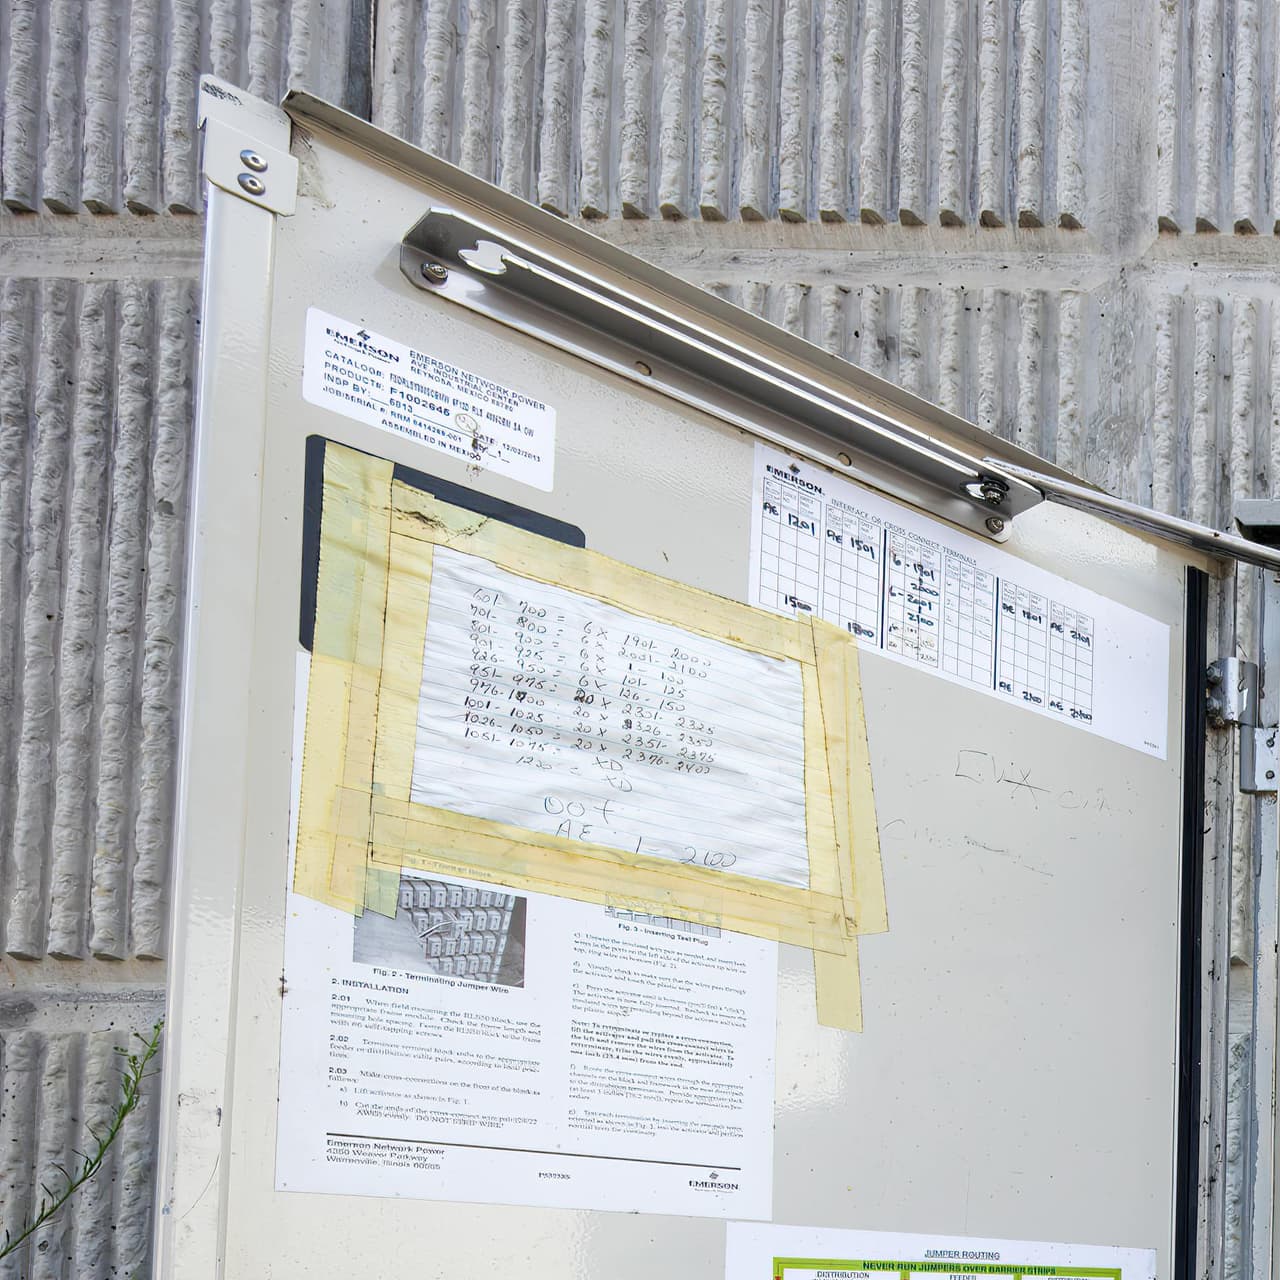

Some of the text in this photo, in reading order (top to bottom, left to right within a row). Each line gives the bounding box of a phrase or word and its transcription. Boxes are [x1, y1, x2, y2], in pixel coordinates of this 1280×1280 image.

[326, 328, 400, 363] EMERSON
[410, 351, 459, 376] EMERSON
[461, 371, 509, 398] NETWORK
[512, 392, 546, 411] POWER
[434, 367, 483, 393] INDUSTRIAL
[486, 389, 519, 407] CENTER
[457, 385, 489, 402] MEXICO
[381, 419, 436, 444] ASSEMBLED
[438, 439, 447, 449] IN
[766, 464, 822, 495] EMERSON
[788, 513, 815, 537] 1201
[884, 521, 906, 536] CROSS
[908, 532, 940, 550] CONNECT
[850, 537, 875, 560] 1501
[520, 601, 546, 617] 700
[644, 928, 676, 941] Inserting
[342, 979, 409, 995] INSTALLATION
[405, 973, 456, 986] Terminating
[457, 982, 489, 992] Jumper
[491, 986, 509, 994] Wire
[327, 1140, 371, 1149] Emerson
[416, 1147, 445, 1155] Power
[689, 1180, 739, 1190] EMERSON
[924, 1250, 1000, 1260] JUMPER ROUTING
[817, 1271, 870, 1279] DISTRIBUTION
[863, 1261, 894, 1270] NEVER
[897, 1262, 916, 1271] RUN
[918, 1263, 961, 1272] JUMPERS
[988, 1265, 1025, 1274] BARRIER
[1027, 1267, 1056, 1275] STRIPS
